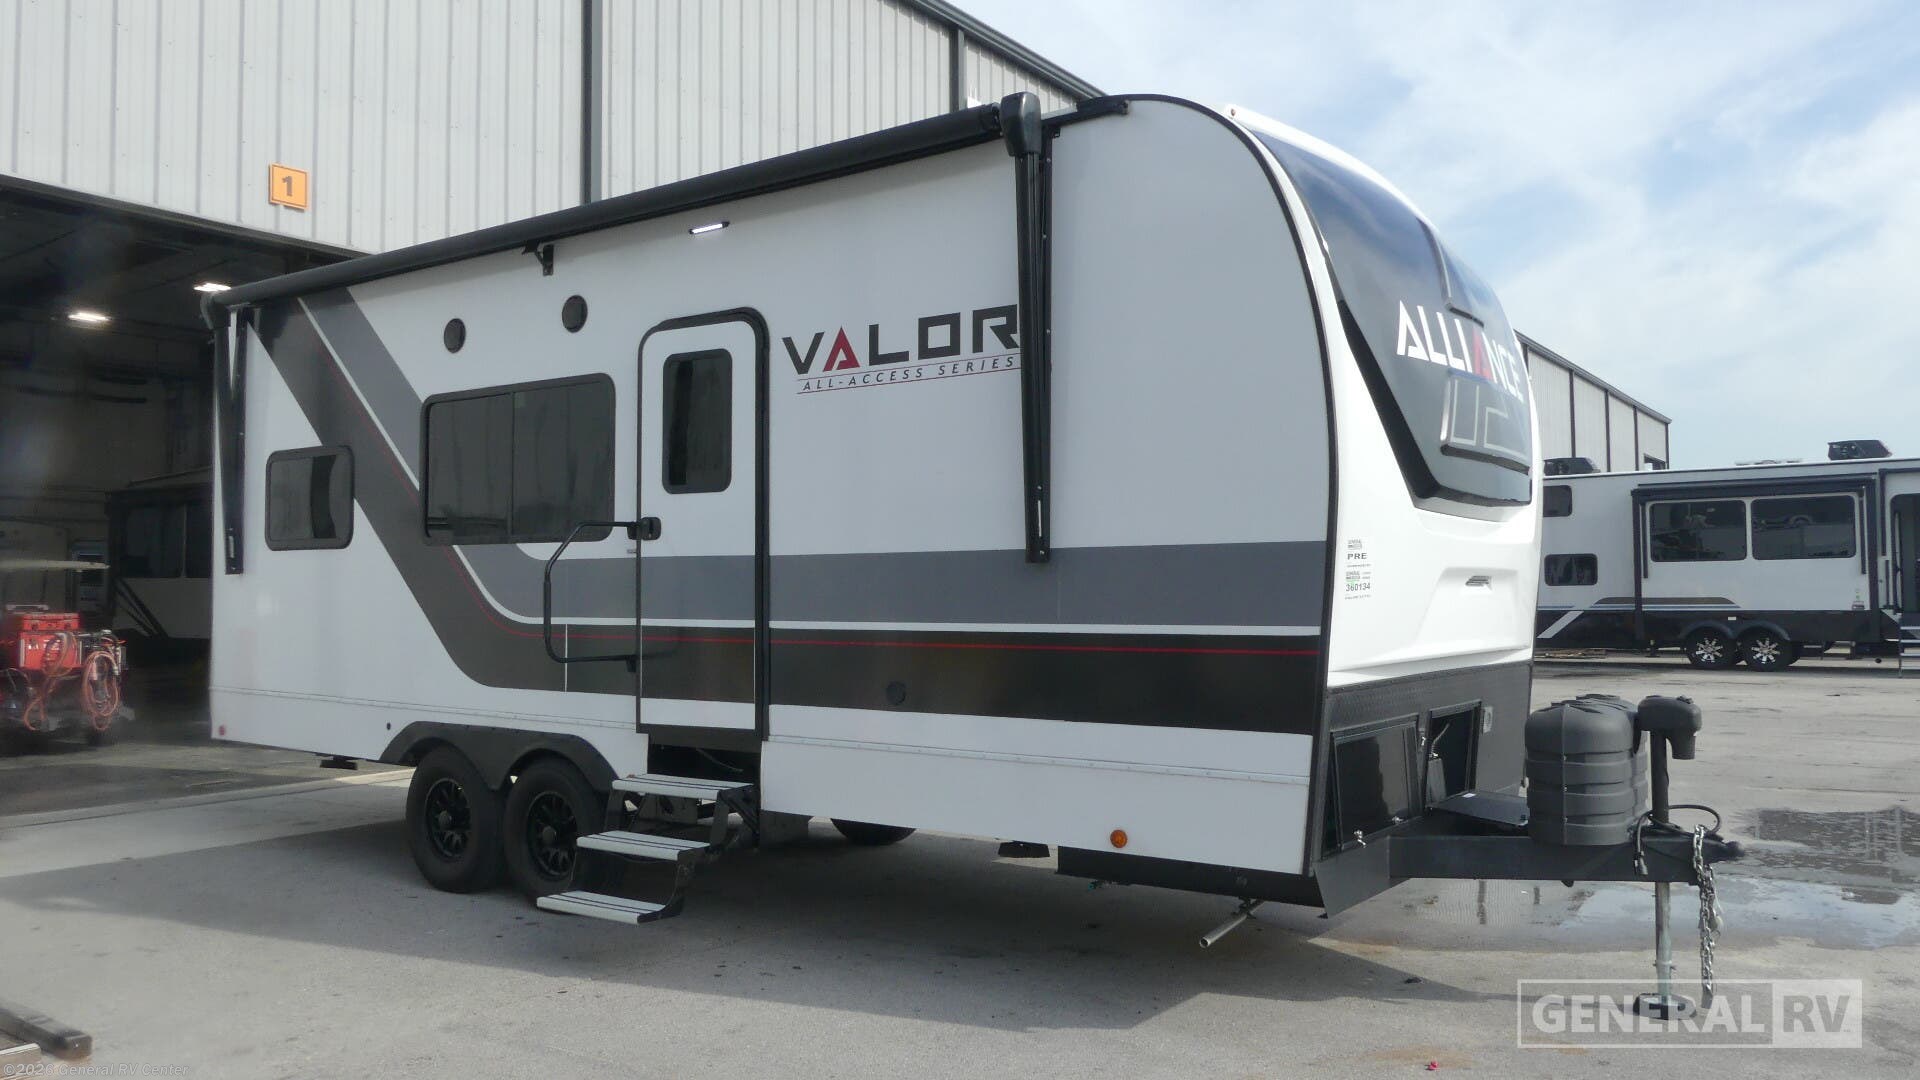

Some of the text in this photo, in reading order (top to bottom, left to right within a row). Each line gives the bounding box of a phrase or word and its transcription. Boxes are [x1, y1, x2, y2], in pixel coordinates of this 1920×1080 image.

[282, 175, 293, 197] 1
[782, 304, 1019, 375] VALOR
[1396, 300, 1524, 404] ALLIANCE
[803, 356, 1014, 391] ALL-ACCESS SERIES
[1347, 552, 1368, 560] PRE
[1345, 582, 1371, 592] 360134
